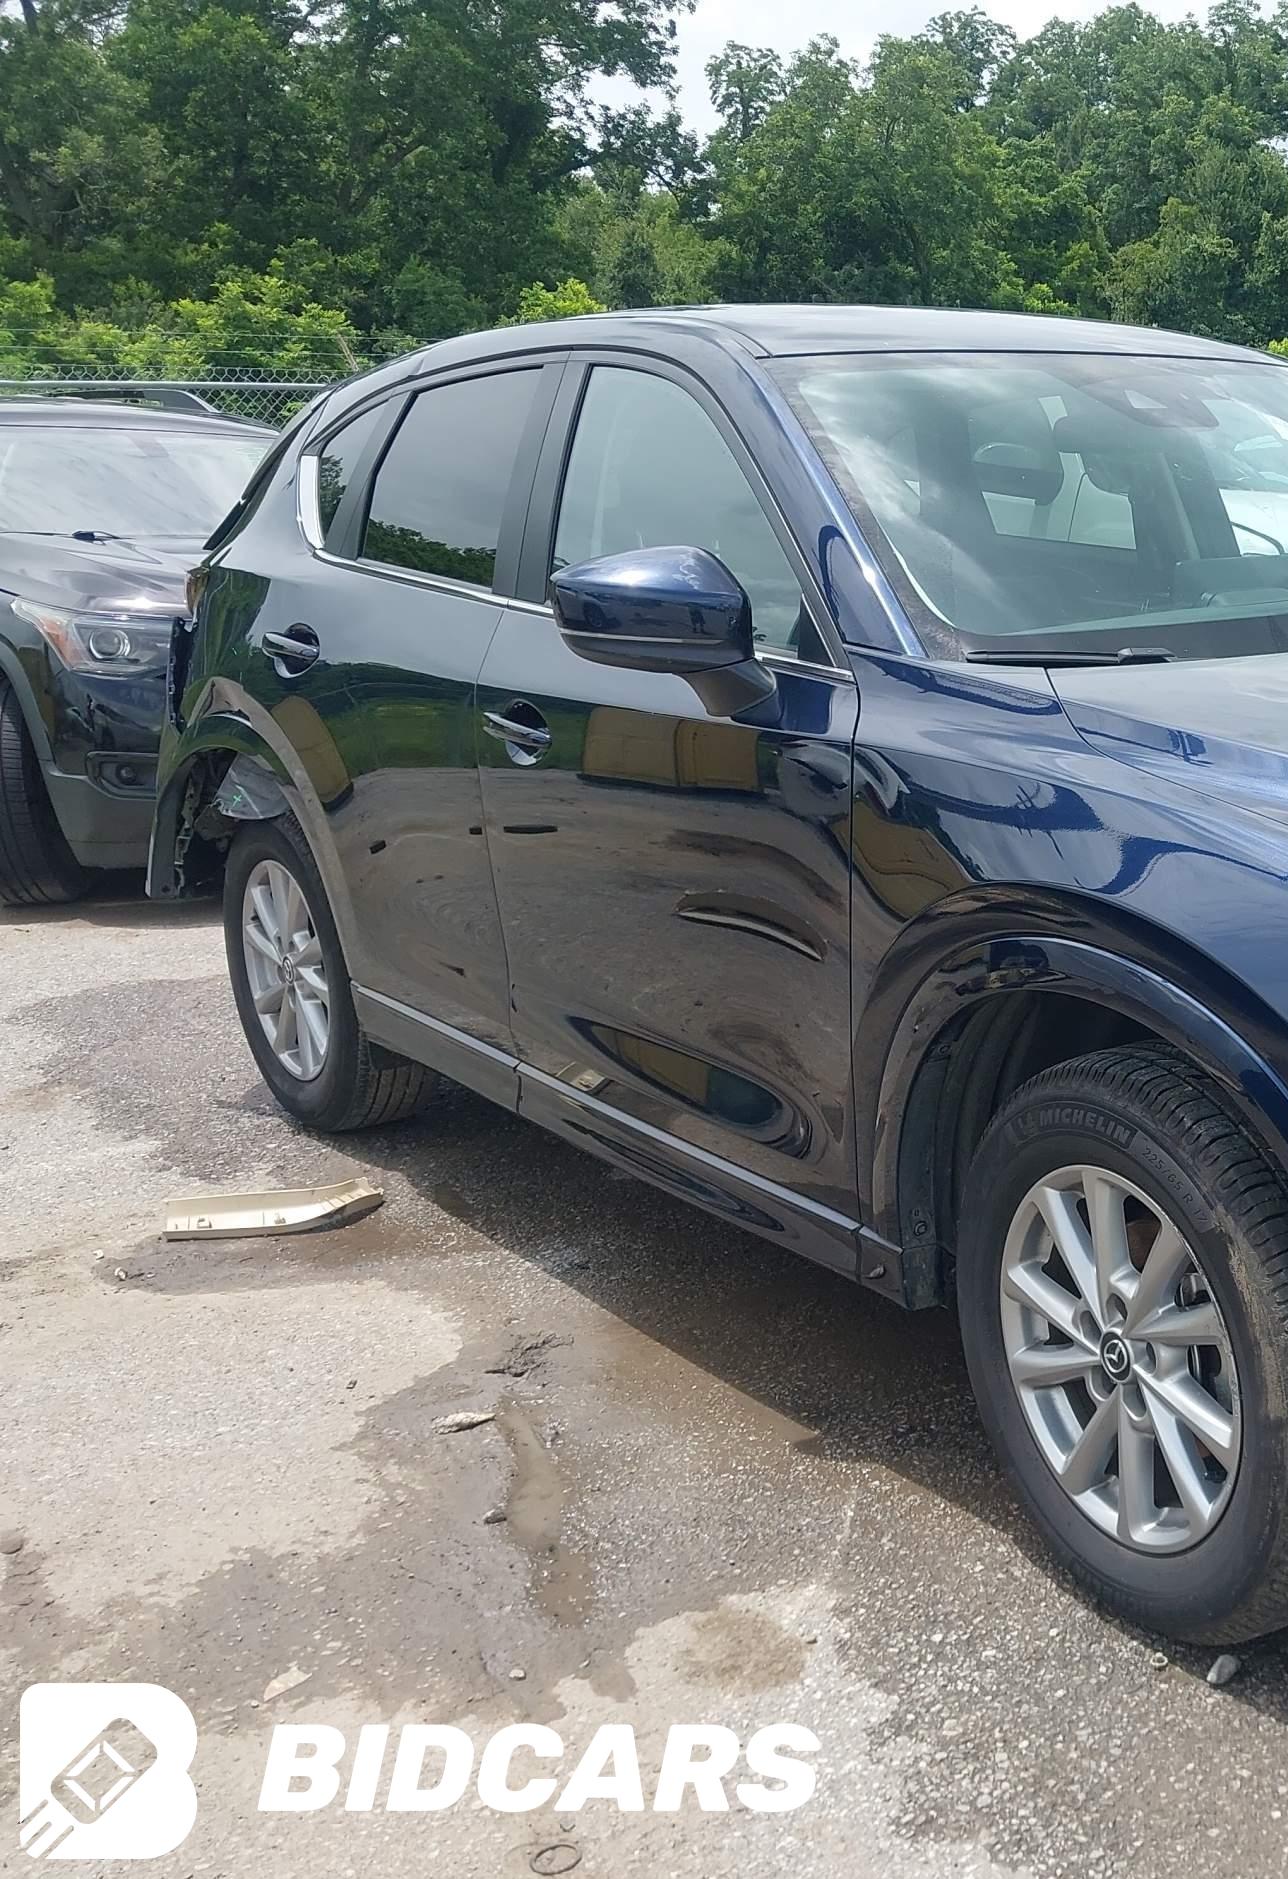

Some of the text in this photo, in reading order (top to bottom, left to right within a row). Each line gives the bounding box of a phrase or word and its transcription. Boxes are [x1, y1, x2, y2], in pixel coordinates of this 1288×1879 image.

[1040, 1109, 1132, 1144] MICHELIN
[1141, 1147, 1184, 1192] 225/65
[1183, 1193, 1194, 1205] R
